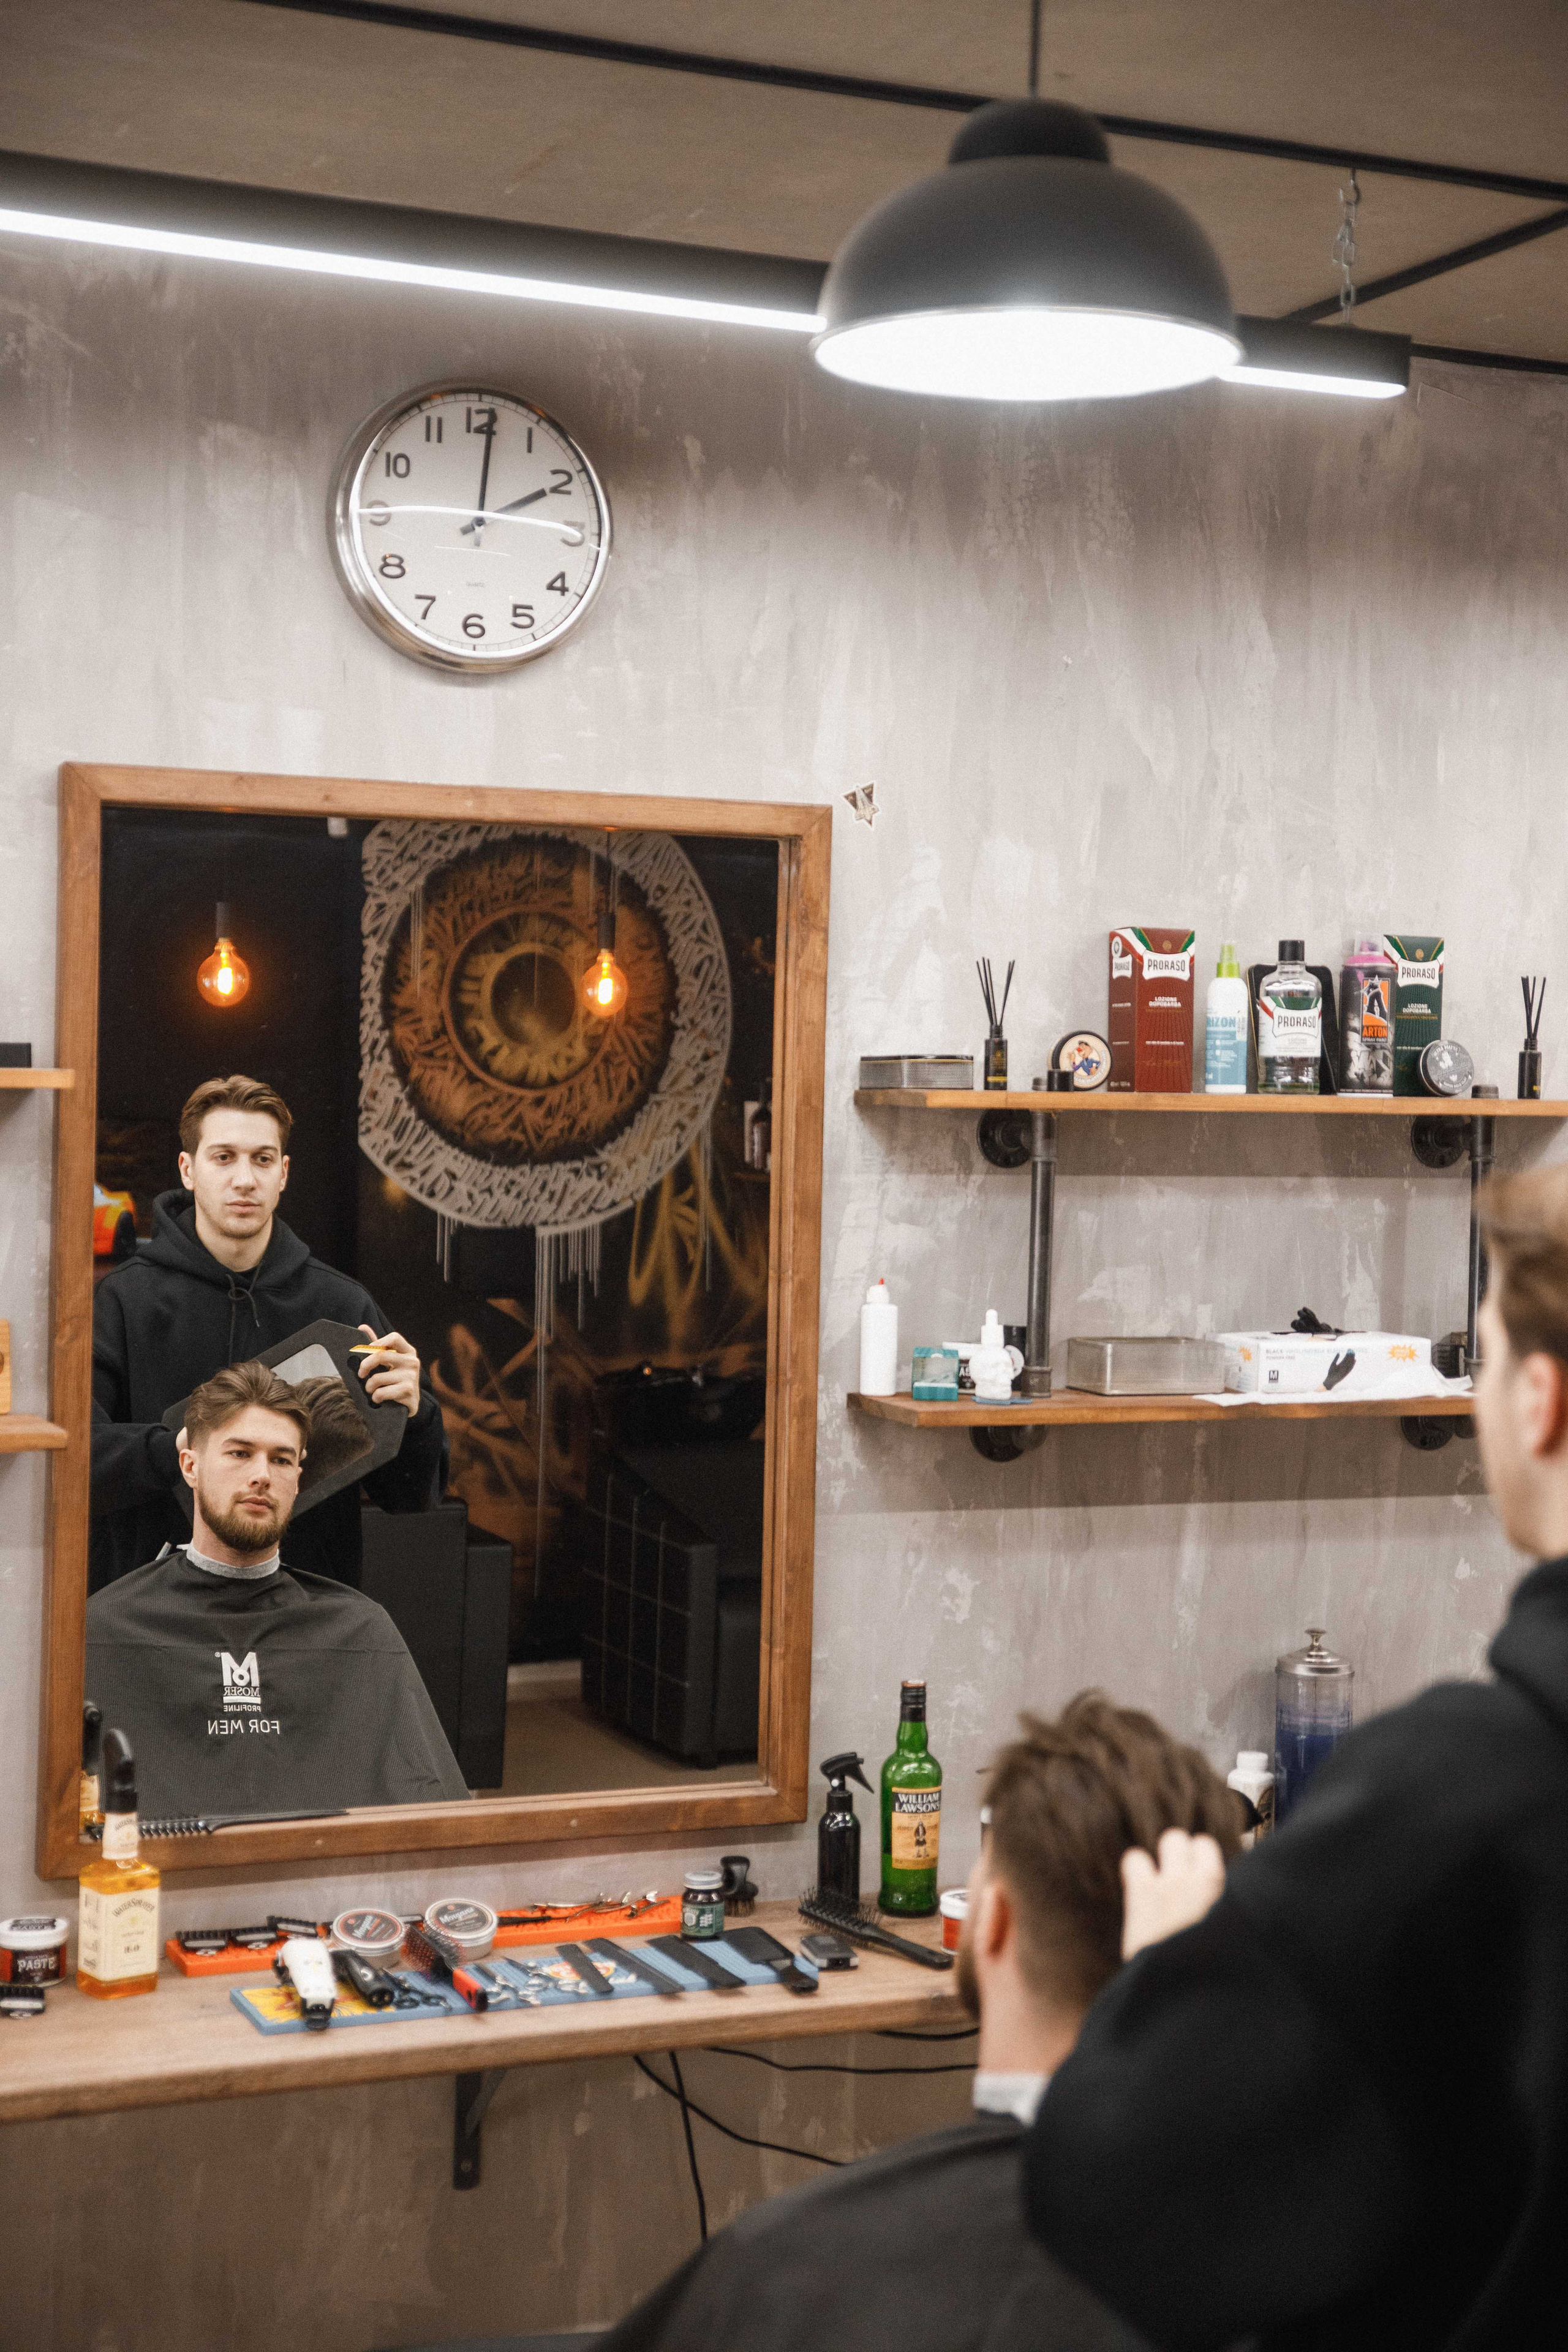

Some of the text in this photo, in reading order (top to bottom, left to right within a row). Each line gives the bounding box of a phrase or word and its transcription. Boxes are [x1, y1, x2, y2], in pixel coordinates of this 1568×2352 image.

[424, 415, 443, 443] 11
[466, 406, 498, 435] 12
[526, 427, 533, 453] 1
[385, 451, 411, 478] 10
[549, 469, 573, 495] 2
[367, 500, 392, 526] 9
[559, 520, 586, 547] 3
[379, 554, 406, 579] 8
[546, 571, 569, 597] 4
[415, 594, 436, 620] 7
[511, 603, 535, 629] 5
[462, 614, 486, 638] 6
[1147, 959, 1186, 972] PRORASO
[1402, 967, 1436, 979] PRORASO
[1278, 1015, 1316, 1028] PRORASO
[1362, 1026, 1388, 1038] ARTON
[898, 1792, 939, 1803] WILLIAM
[17, 1956, 57, 1973] PASTE
